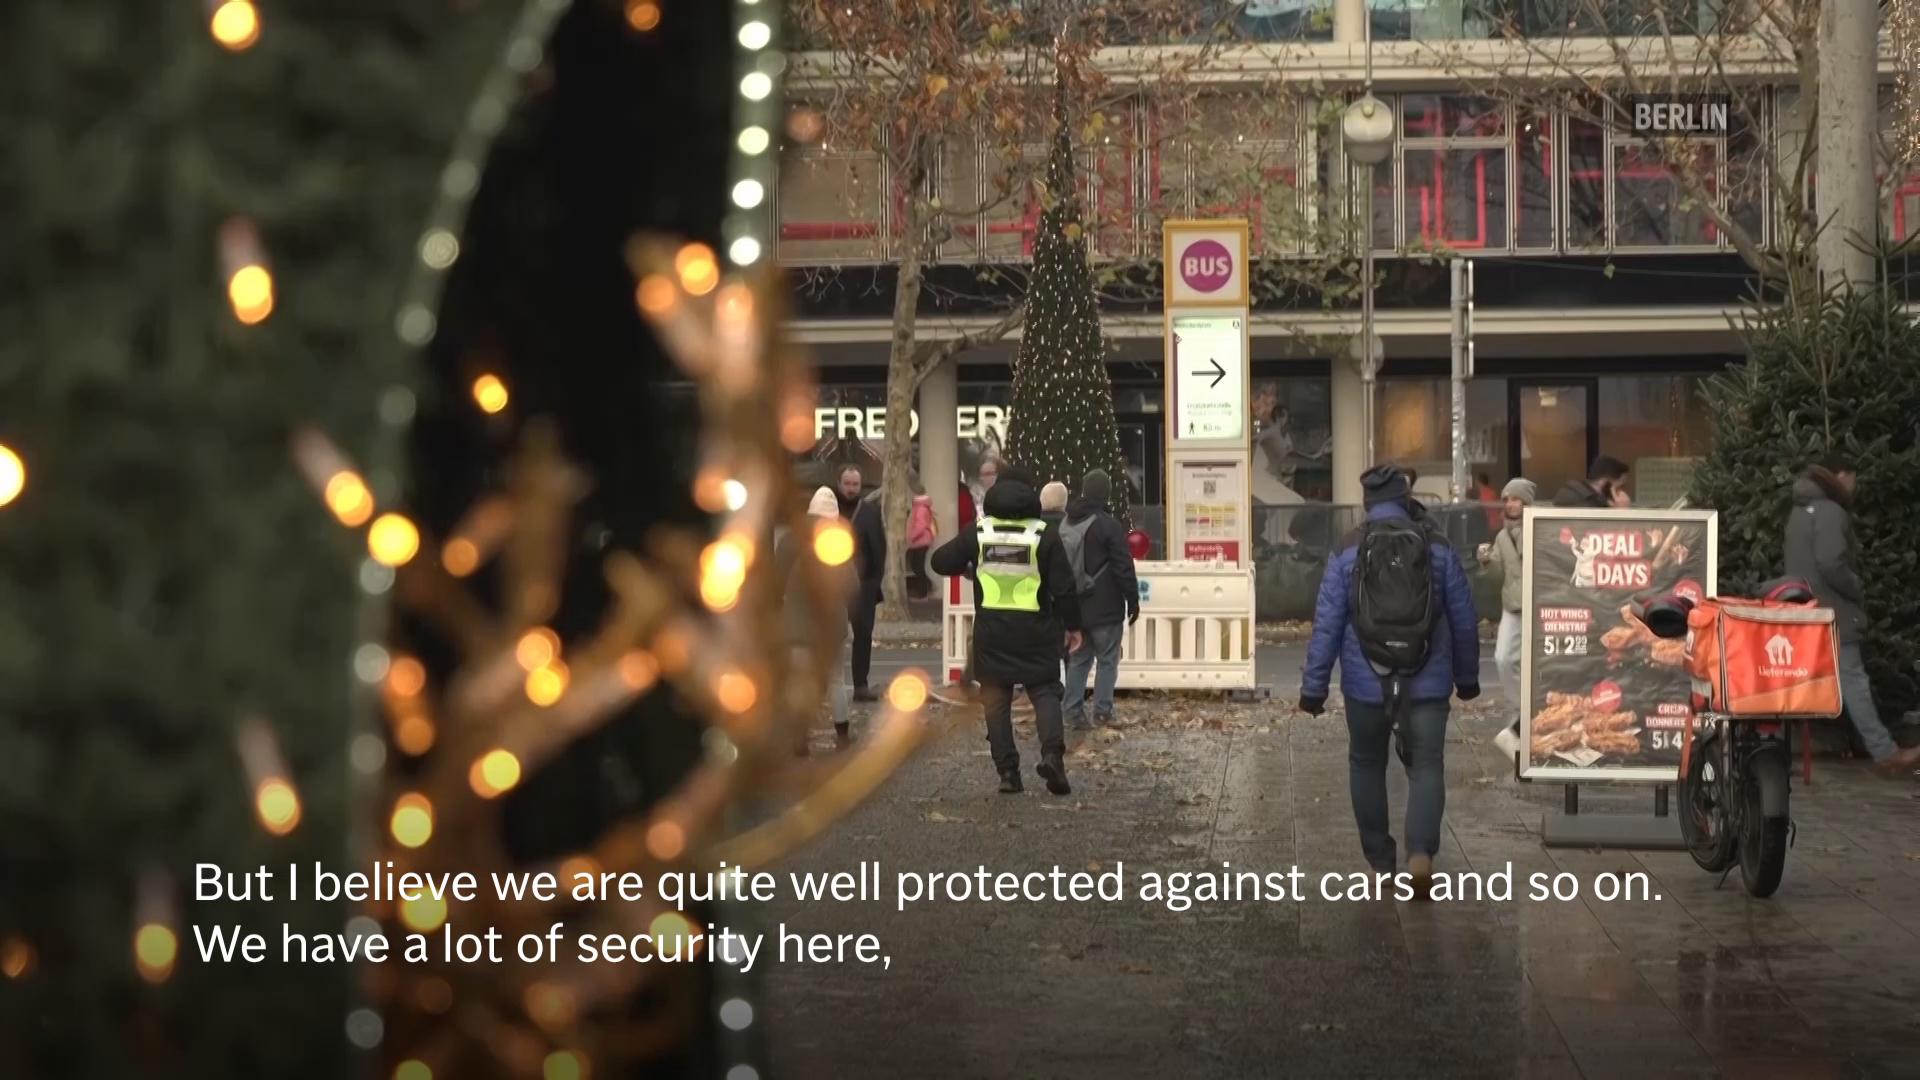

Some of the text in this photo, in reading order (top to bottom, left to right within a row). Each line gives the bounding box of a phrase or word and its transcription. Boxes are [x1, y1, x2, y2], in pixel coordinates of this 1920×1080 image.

[1184, 257, 1229, 277] BUS
[1588, 533, 1641, 556] DEAL
[1597, 563, 1648, 586] DAYS
[1540, 608, 1589, 620] HOT WINGS
[1544, 622, 1587, 632] DIENSTAG
